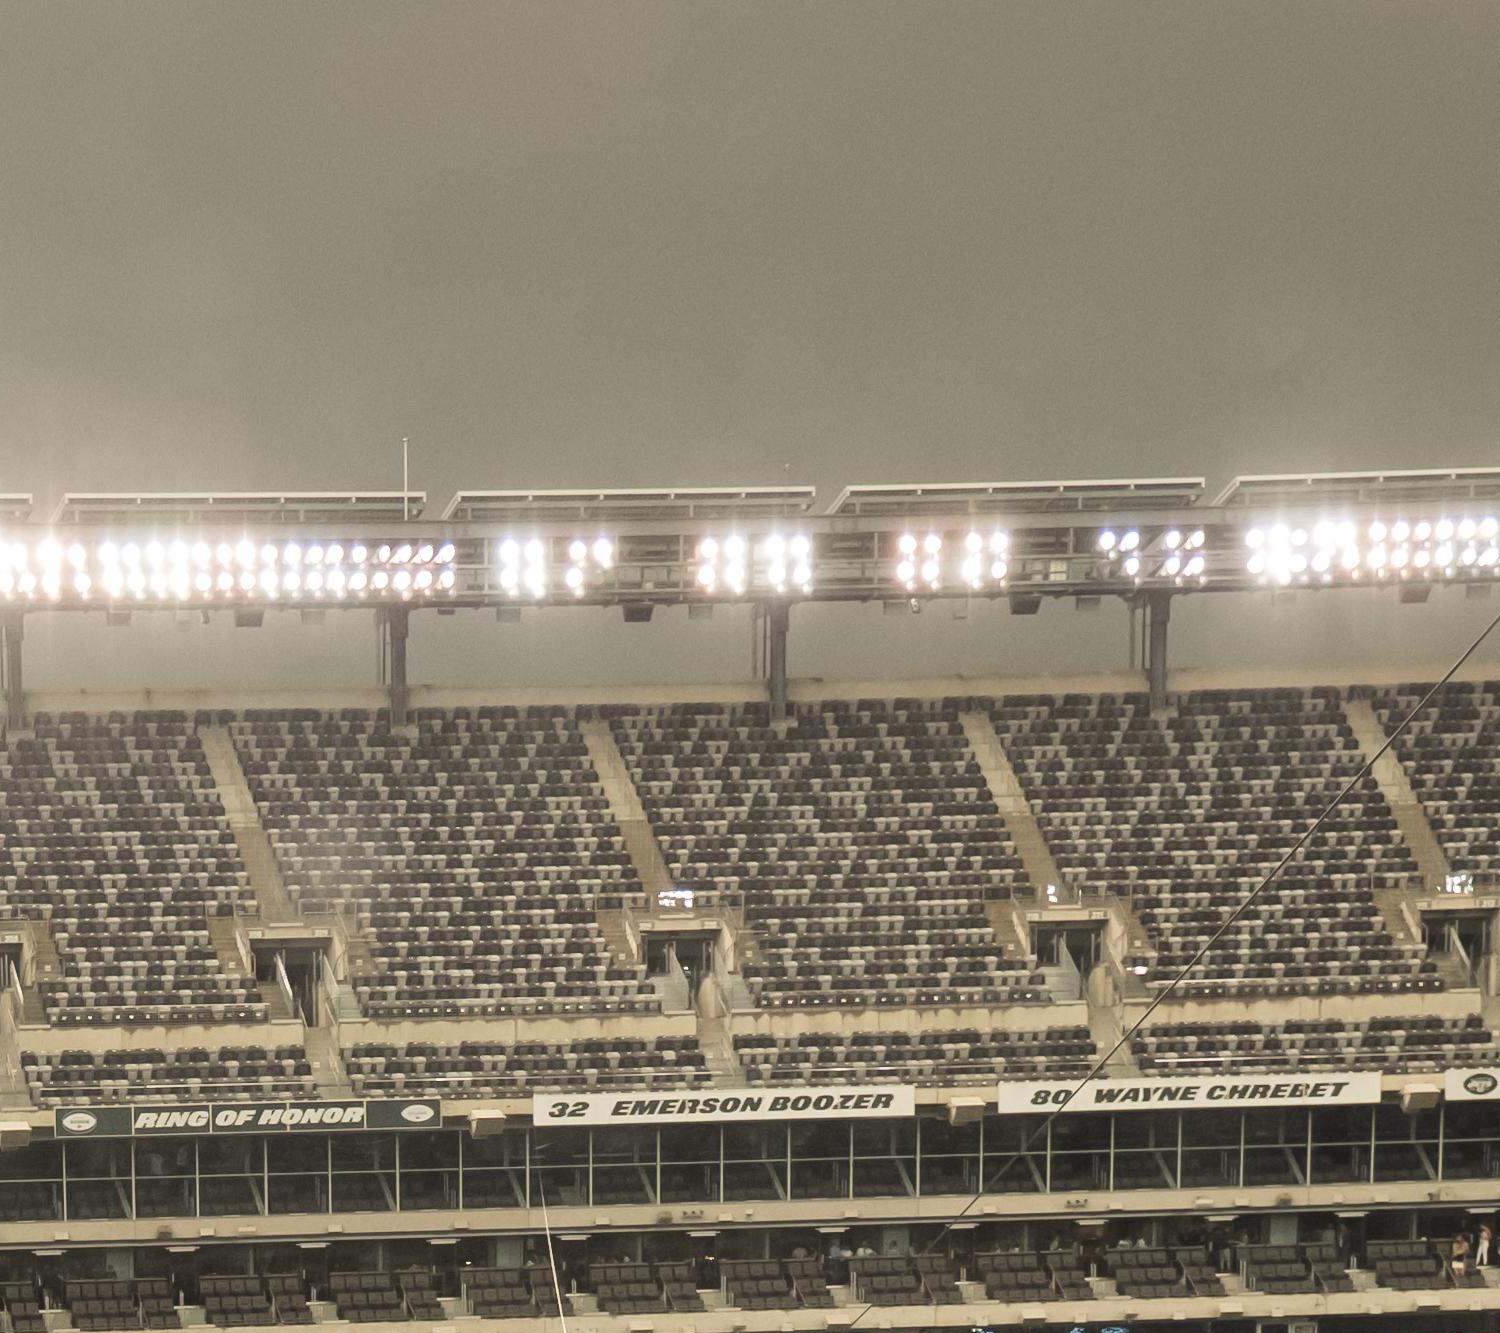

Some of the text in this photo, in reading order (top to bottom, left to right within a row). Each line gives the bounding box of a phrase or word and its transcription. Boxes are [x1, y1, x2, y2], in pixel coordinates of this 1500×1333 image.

[1031, 1082, 1349, 1104] 80 WAYNE CHREBET
[548, 1094, 894, 1118] 32 EMERSON BOOZER
[134, 1107, 365, 1130] RING OF HONOR
